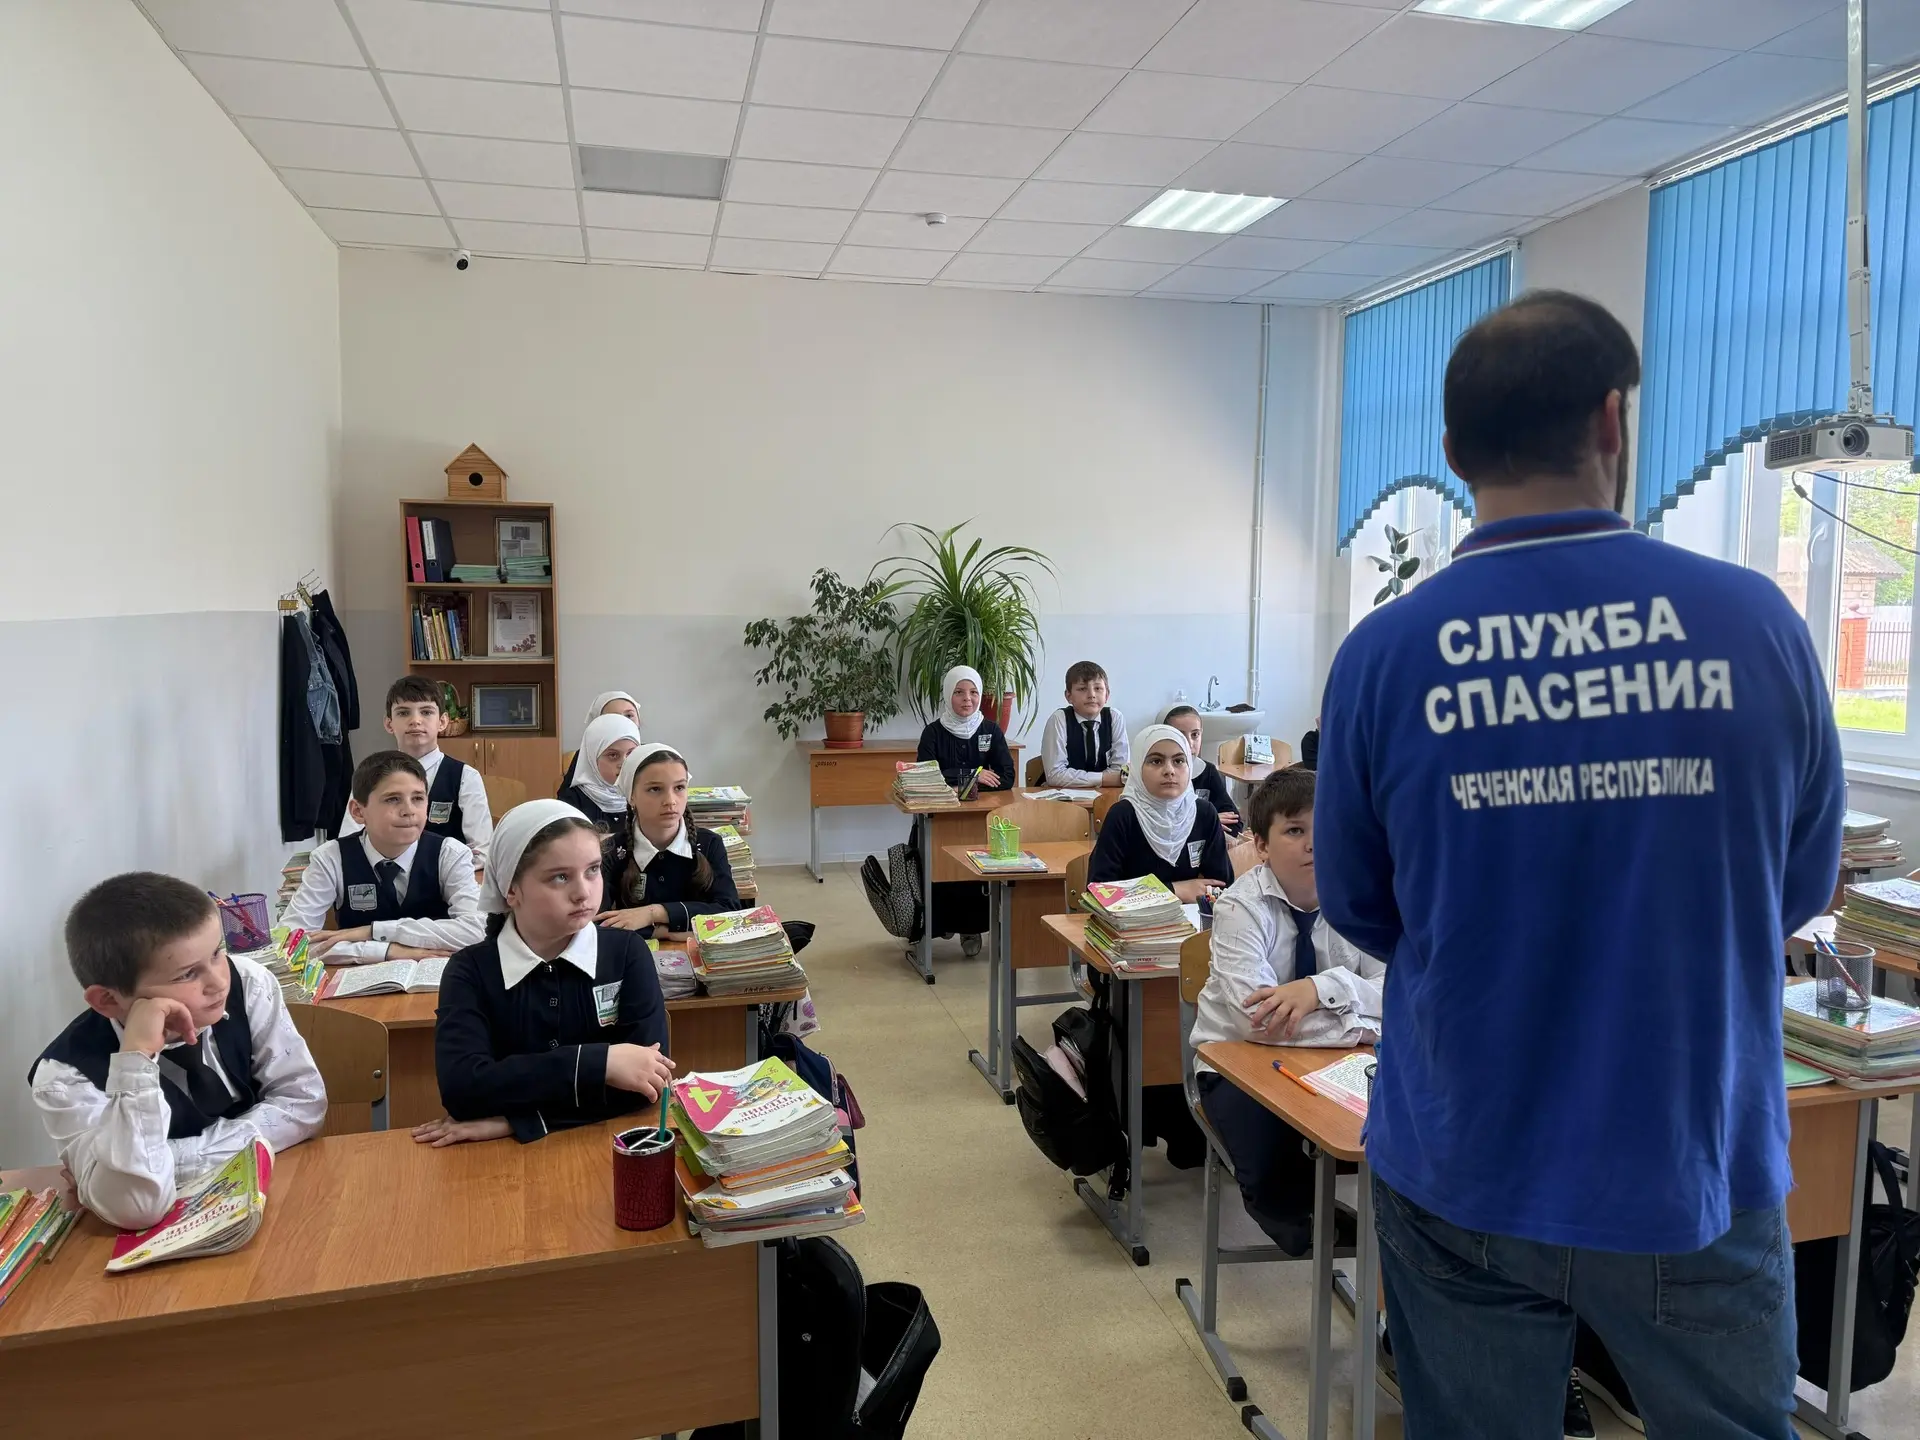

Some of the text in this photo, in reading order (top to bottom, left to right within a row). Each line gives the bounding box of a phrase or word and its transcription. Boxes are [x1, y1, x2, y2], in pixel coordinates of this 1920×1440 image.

[1438, 596, 1687, 666] СЛУЖБА
[1425, 660, 1734, 734] СПАСЕНИЯ
[1451, 758, 1715, 810] ЧЕЧЕНСКАЯ РЕСПУБЛИКА
[688, 1087, 722, 1113] 4
[732, 1093, 808, 1125] Литературное
